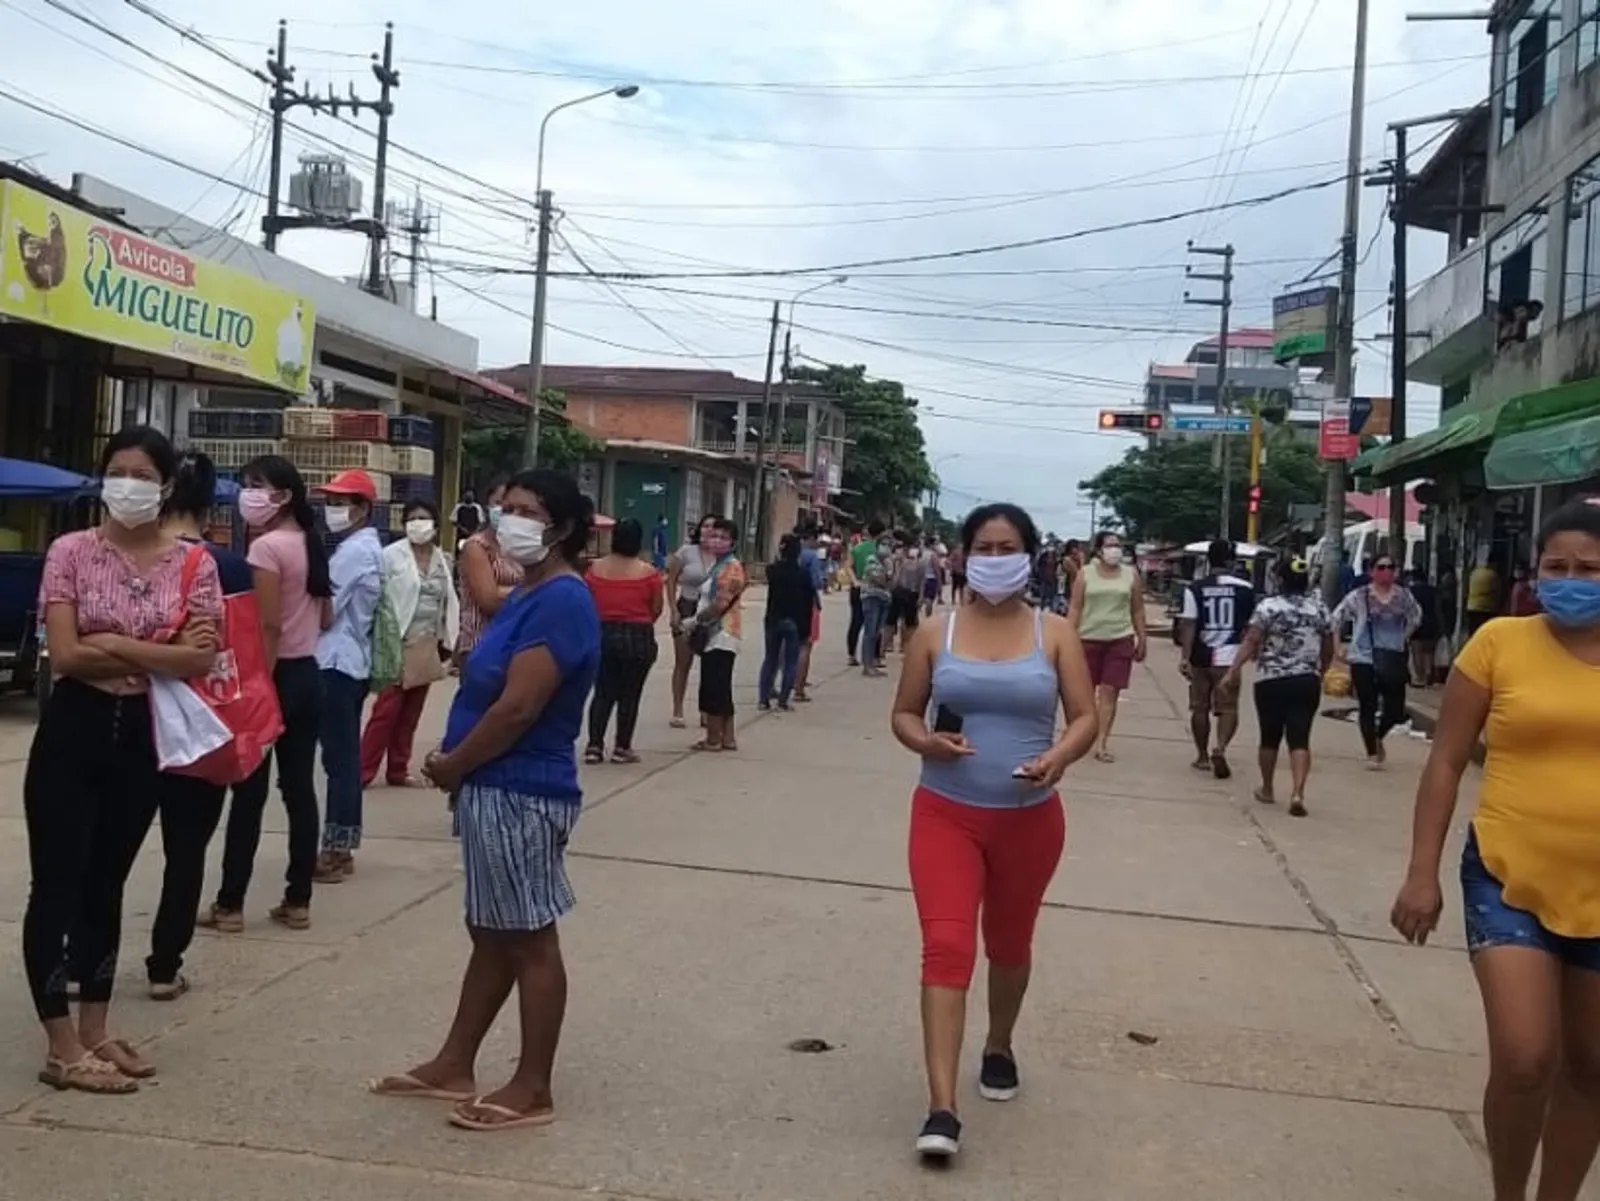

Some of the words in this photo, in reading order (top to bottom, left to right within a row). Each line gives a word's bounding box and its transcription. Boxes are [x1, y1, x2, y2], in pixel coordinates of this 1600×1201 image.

[118, 238, 186, 282] Avícola
[93, 270, 254, 349] MIGUELITO
[1203, 598, 1234, 629] 10
